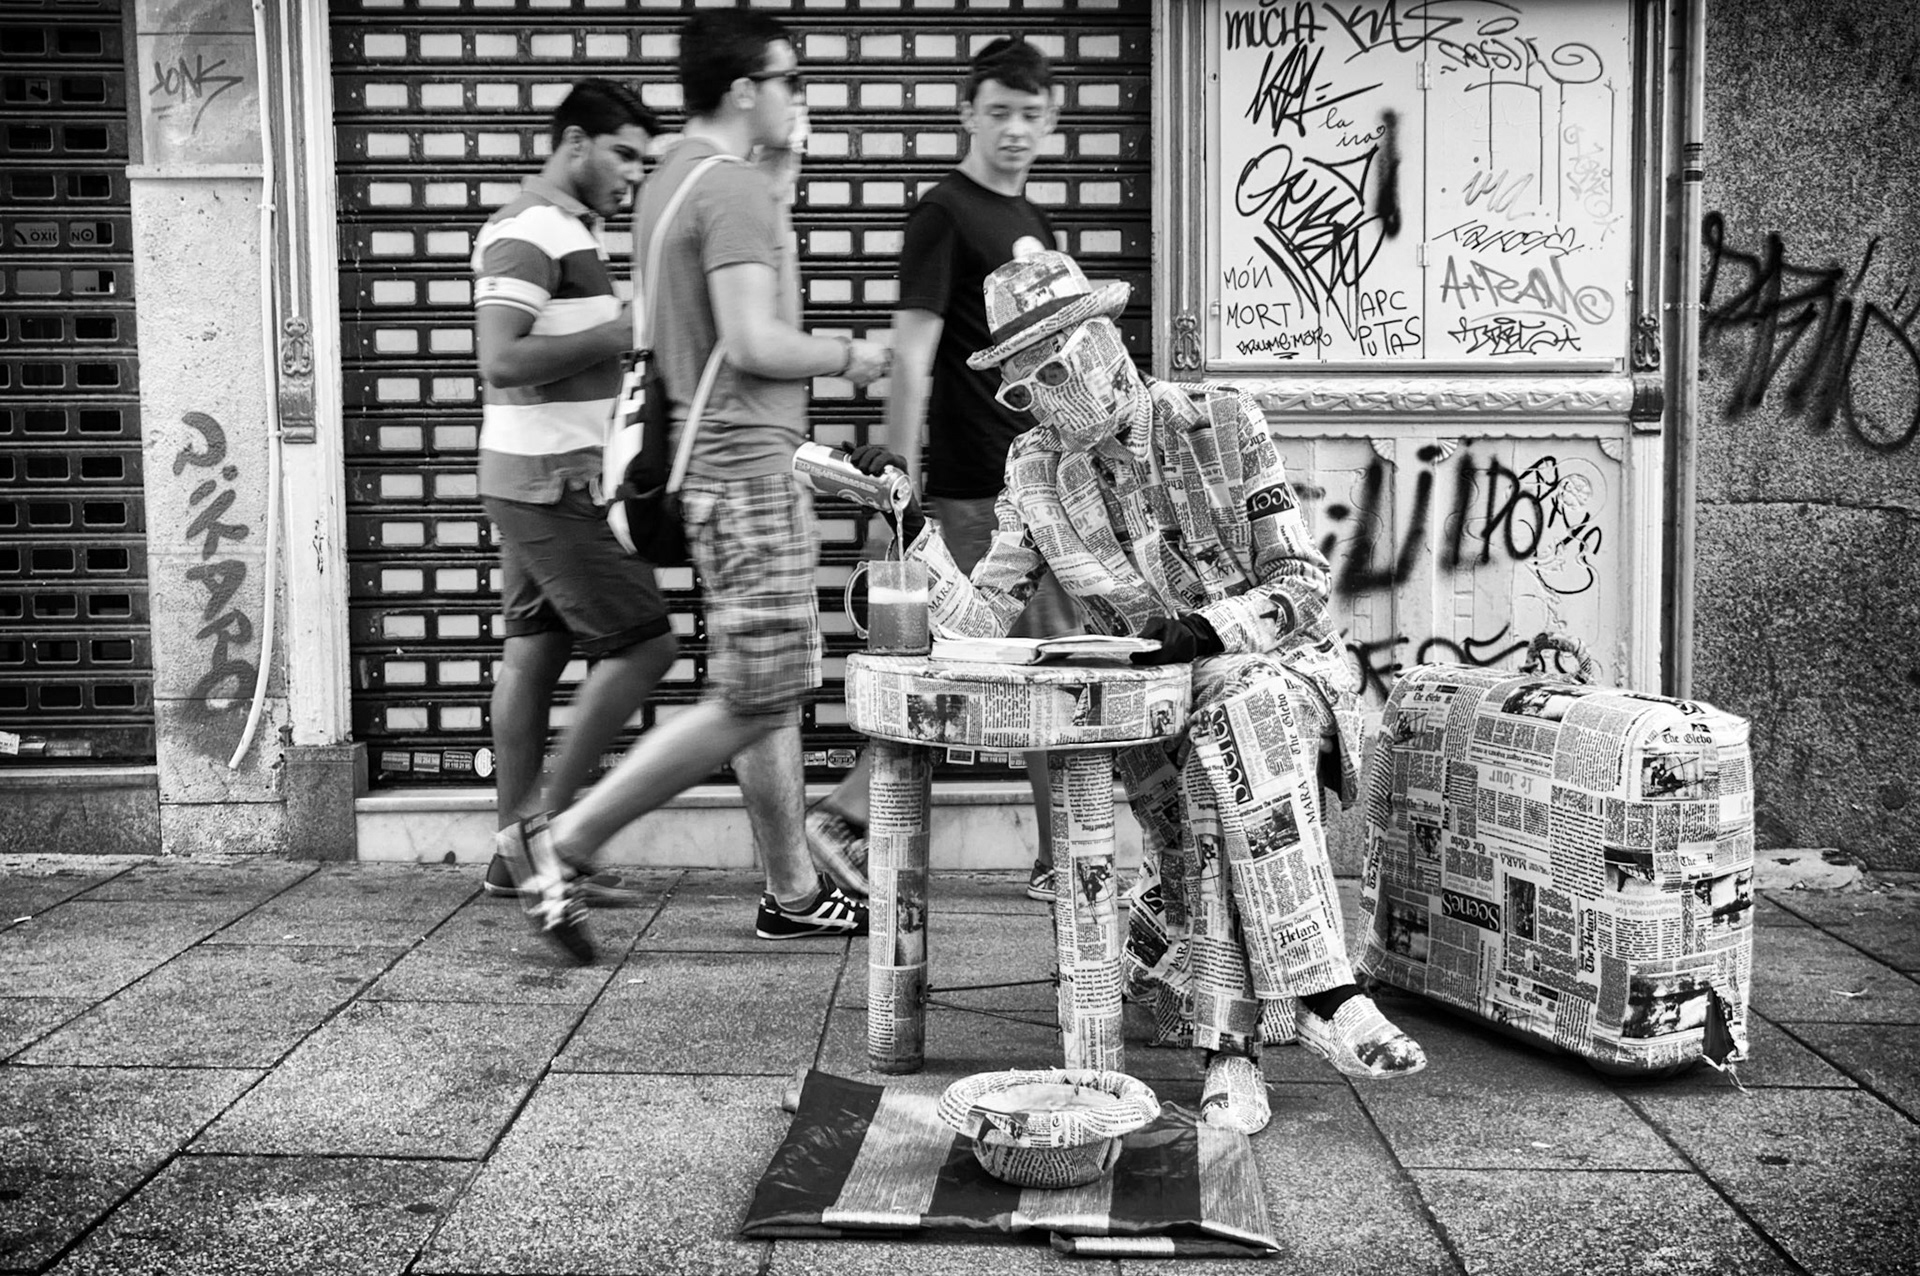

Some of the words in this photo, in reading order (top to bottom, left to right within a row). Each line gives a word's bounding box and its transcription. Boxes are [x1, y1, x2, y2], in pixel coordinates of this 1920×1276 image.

[1318, 107, 1354, 129] la
[1226, 303, 1291, 330] MORT
[1361, 292, 1408, 322] APC
[1359, 317, 1421, 356] PUTAS
[1290, 735, 1301, 755] The
[1662, 733, 1679, 744] The
[1298, 781, 1318, 824] MARA
